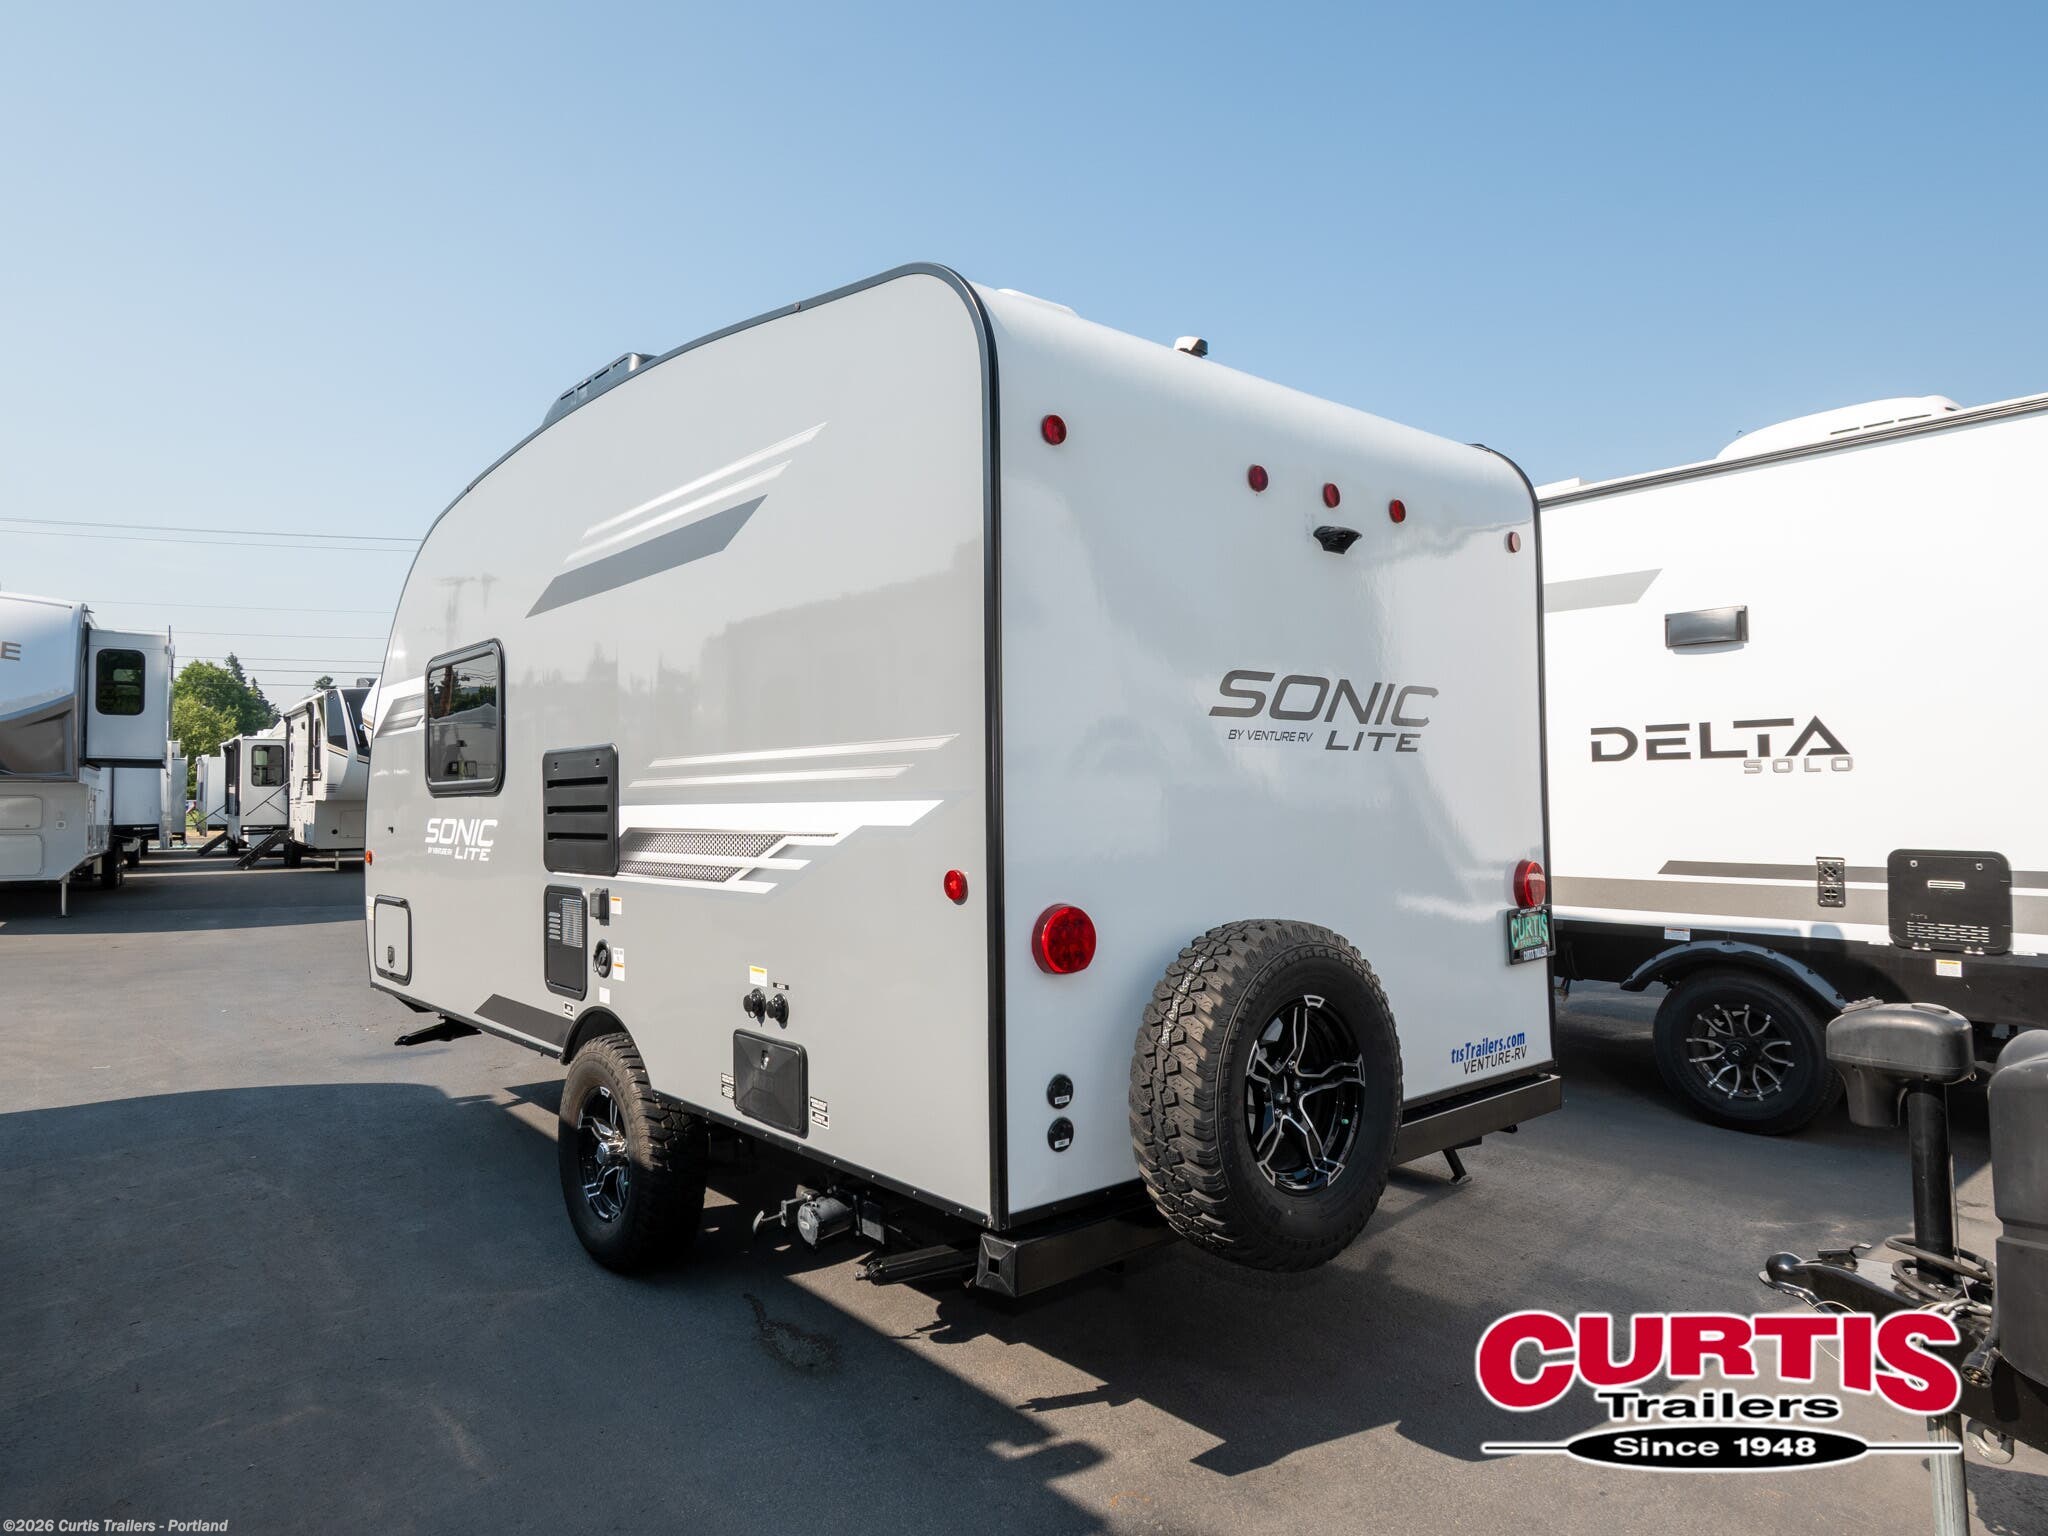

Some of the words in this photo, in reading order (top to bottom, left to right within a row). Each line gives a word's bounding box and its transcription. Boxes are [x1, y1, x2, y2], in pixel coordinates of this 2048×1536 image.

[1208, 669, 1439, 728] SONIC
[1228, 729, 1245, 741] BY
[1247, 730, 1297, 742] VENTURE
[1298, 732, 1313, 743] RV
[1325, 730, 1421, 753] LITE
[1590, 715, 1850, 762] DELTA
[1743, 756, 1854, 774] SOLO
[424, 817, 498, 848] SONIC
[454, 846, 491, 862] LITE
[1511, 914, 1549, 948] CURTIS
[1463, 1045, 1527, 1075] VENTURE-RV
